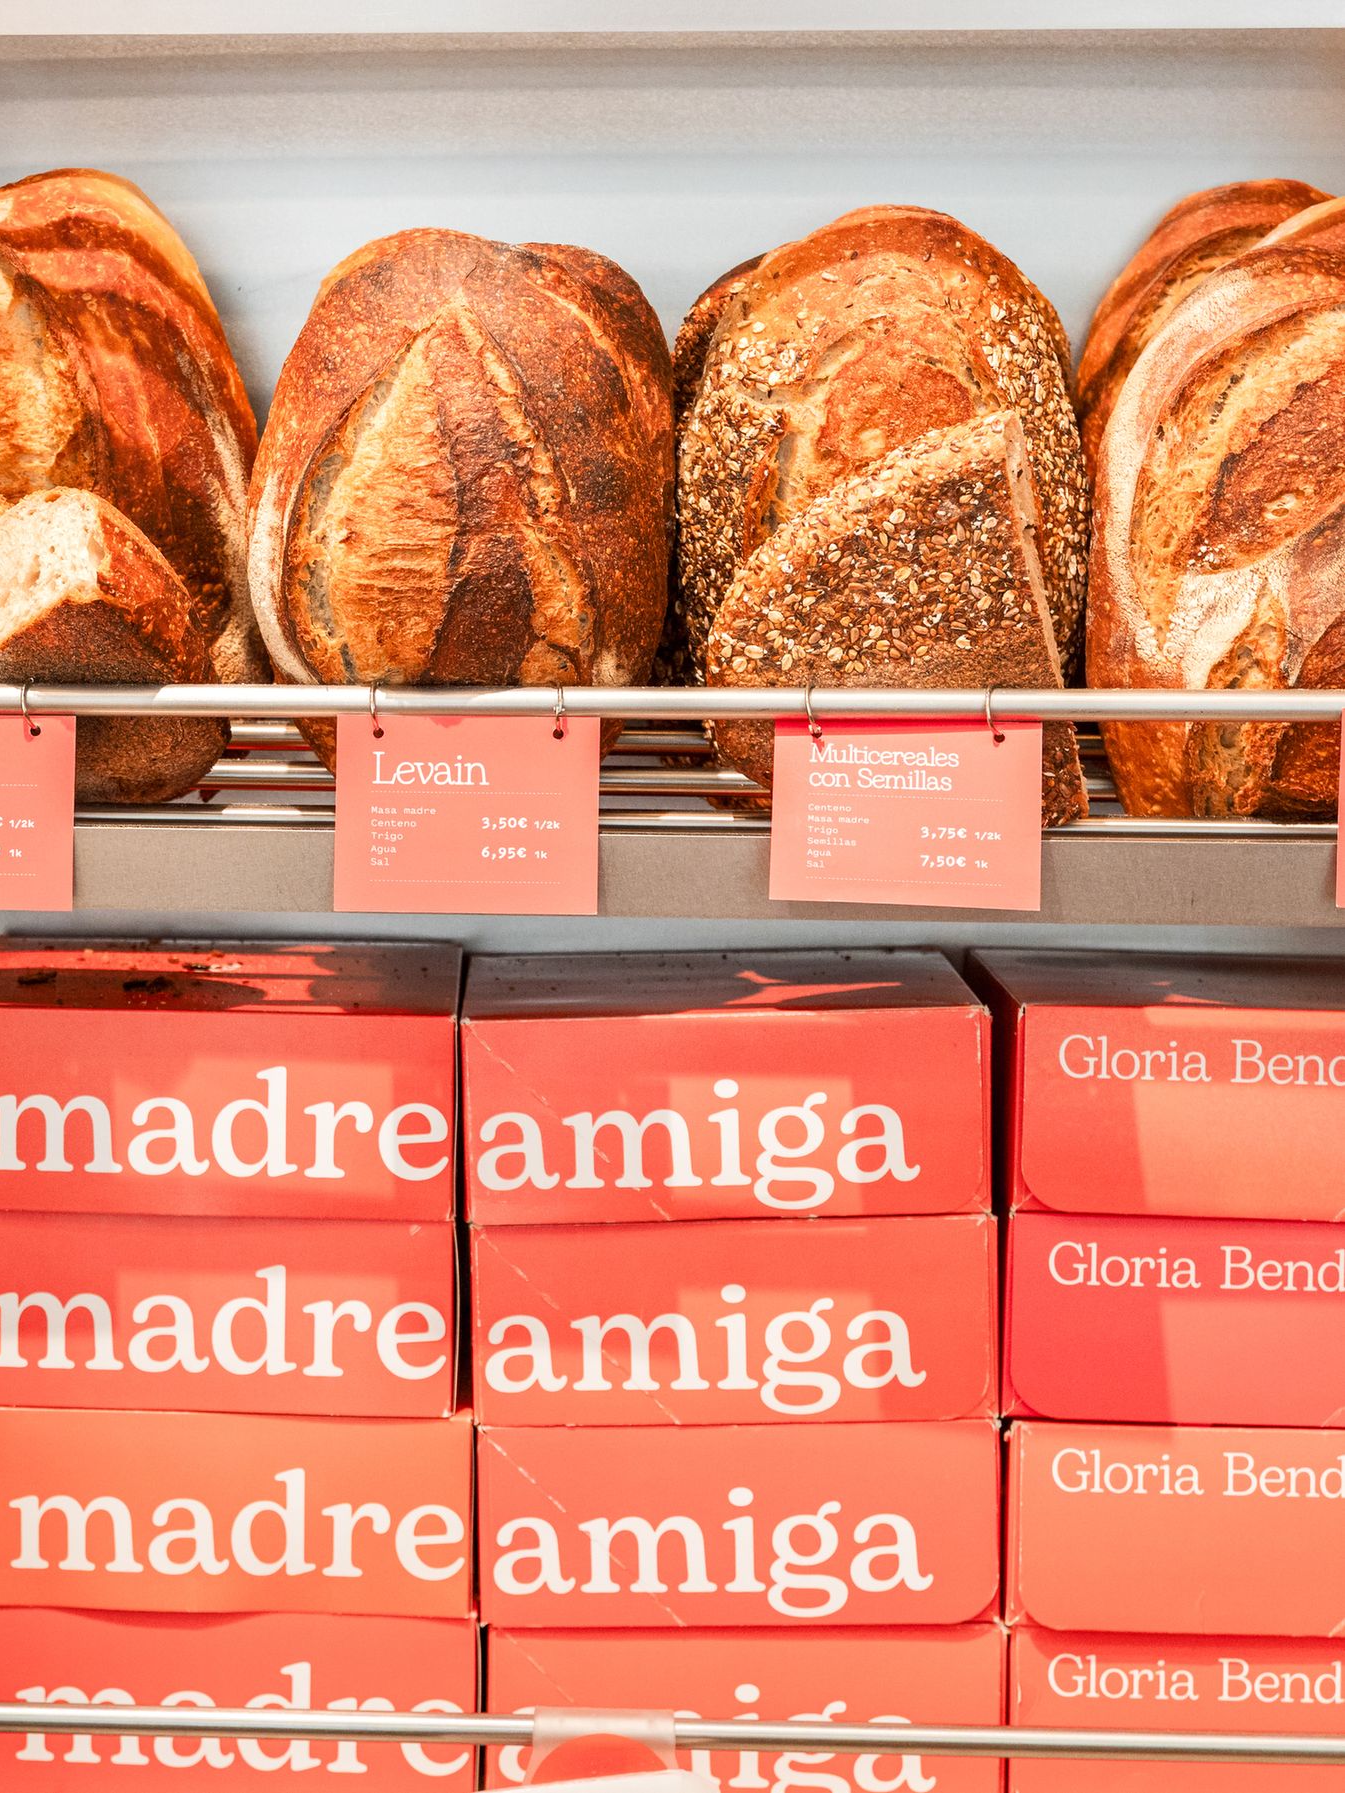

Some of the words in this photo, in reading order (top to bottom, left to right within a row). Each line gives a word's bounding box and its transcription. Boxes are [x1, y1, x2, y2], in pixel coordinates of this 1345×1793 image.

[809, 743, 959, 767] Multicereales
[372, 752, 489, 785] Levain
[808, 771, 851, 788] con
[856, 768, 952, 791] Semillas
[370, 806, 397, 814] Masa
[403, 806, 436, 814] madre
[807, 804, 851, 812] Centeno
[8, 820, 34, 828] 1/2k
[370, 819, 417, 827] Centeno
[481, 817, 527, 830] 3,50€
[533, 821, 560, 829] 1/2k
[807, 815, 832, 824] Masa
[838, 816, 870, 825] madre
[371, 832, 404, 842] Trigo
[808, 826, 838, 835] Trigo
[920, 827, 967, 840] 3,75€
[974, 832, 1001, 840] 1/2k
[806, 837, 857, 846] Semillas
[8, 849, 22, 857] 1k
[370, 845, 397, 854] Agua
[481, 847, 527, 860] 6,95€
[534, 850, 547, 859] 1k
[806, 849, 831, 857] Agua
[370, 858, 390, 866] Sal
[805, 860, 825, 868] Sal
[920, 855, 966, 868] 7,50€
[974, 860, 988, 869] 1k
[1058, 1035, 1211, 1082] Gloria
[477, 1079, 920, 1209] amiga
[1048, 1241, 1201, 1288] Gloria
[484, 1285, 926, 1414] amiga
[1051, 1448, 1204, 1495] Gloria
[9, 1468, 464, 1580] madre
[493, 1487, 933, 1617] amiga
[1047, 1654, 1198, 1700] Gloria
